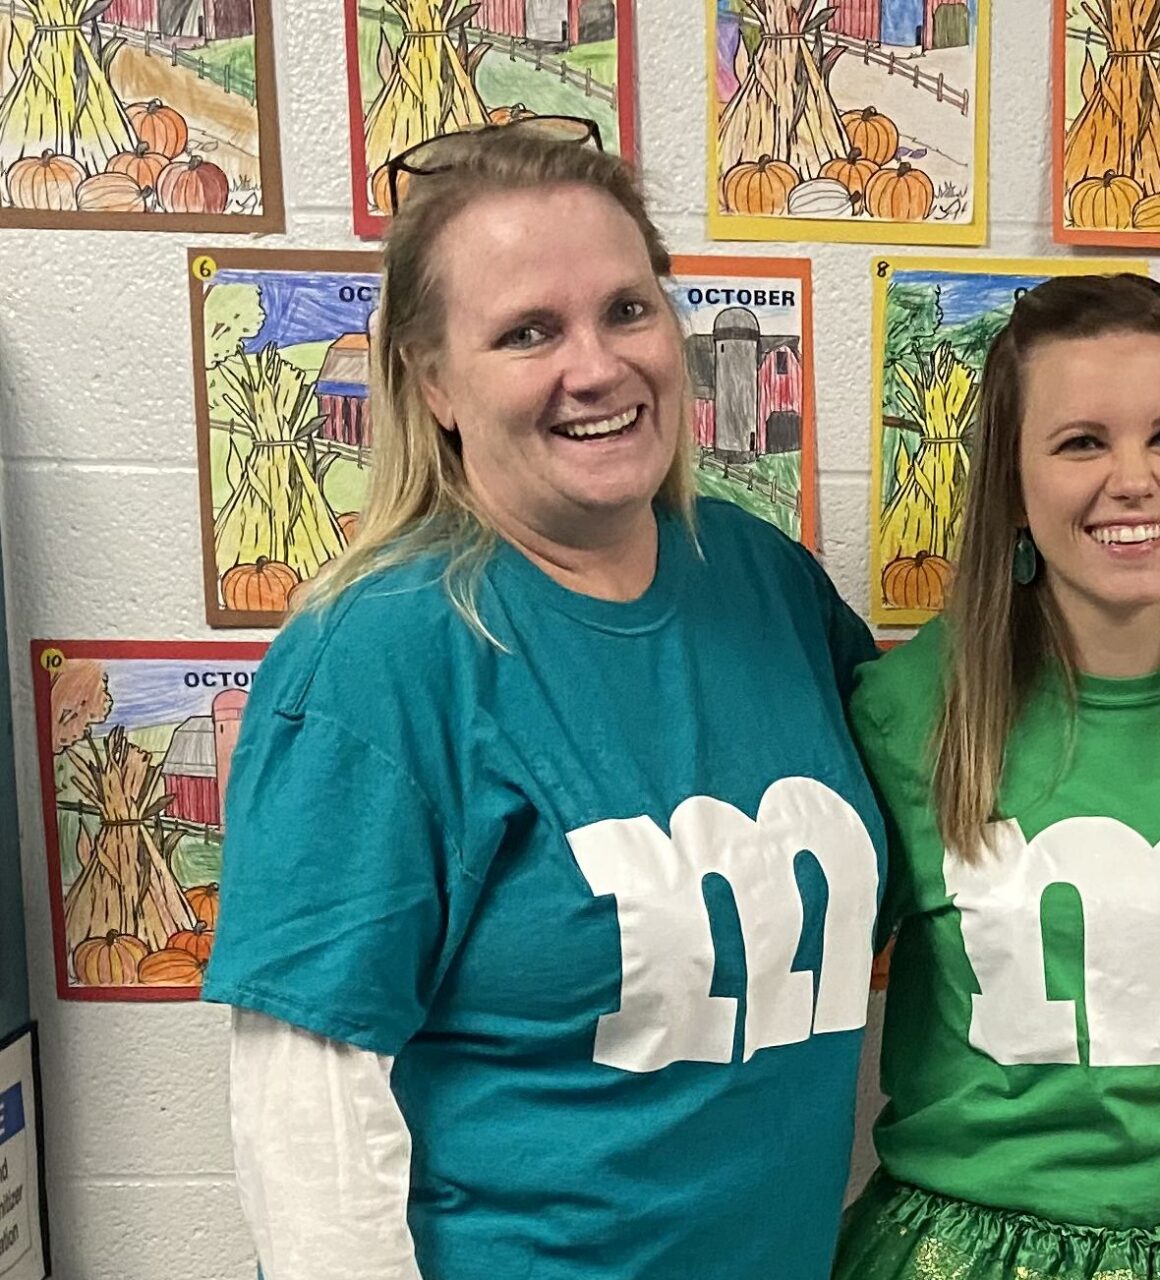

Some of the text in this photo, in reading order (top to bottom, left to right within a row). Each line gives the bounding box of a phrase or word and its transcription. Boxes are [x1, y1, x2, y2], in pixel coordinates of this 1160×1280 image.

[199, 259, 212, 278] 6
[876, 260, 890, 278] 8
[687, 287, 796, 307] OCTOBER
[46, 654, 62, 669] 10
[184, 671, 257, 688] OCTO
[565, 776, 878, 1073] m
